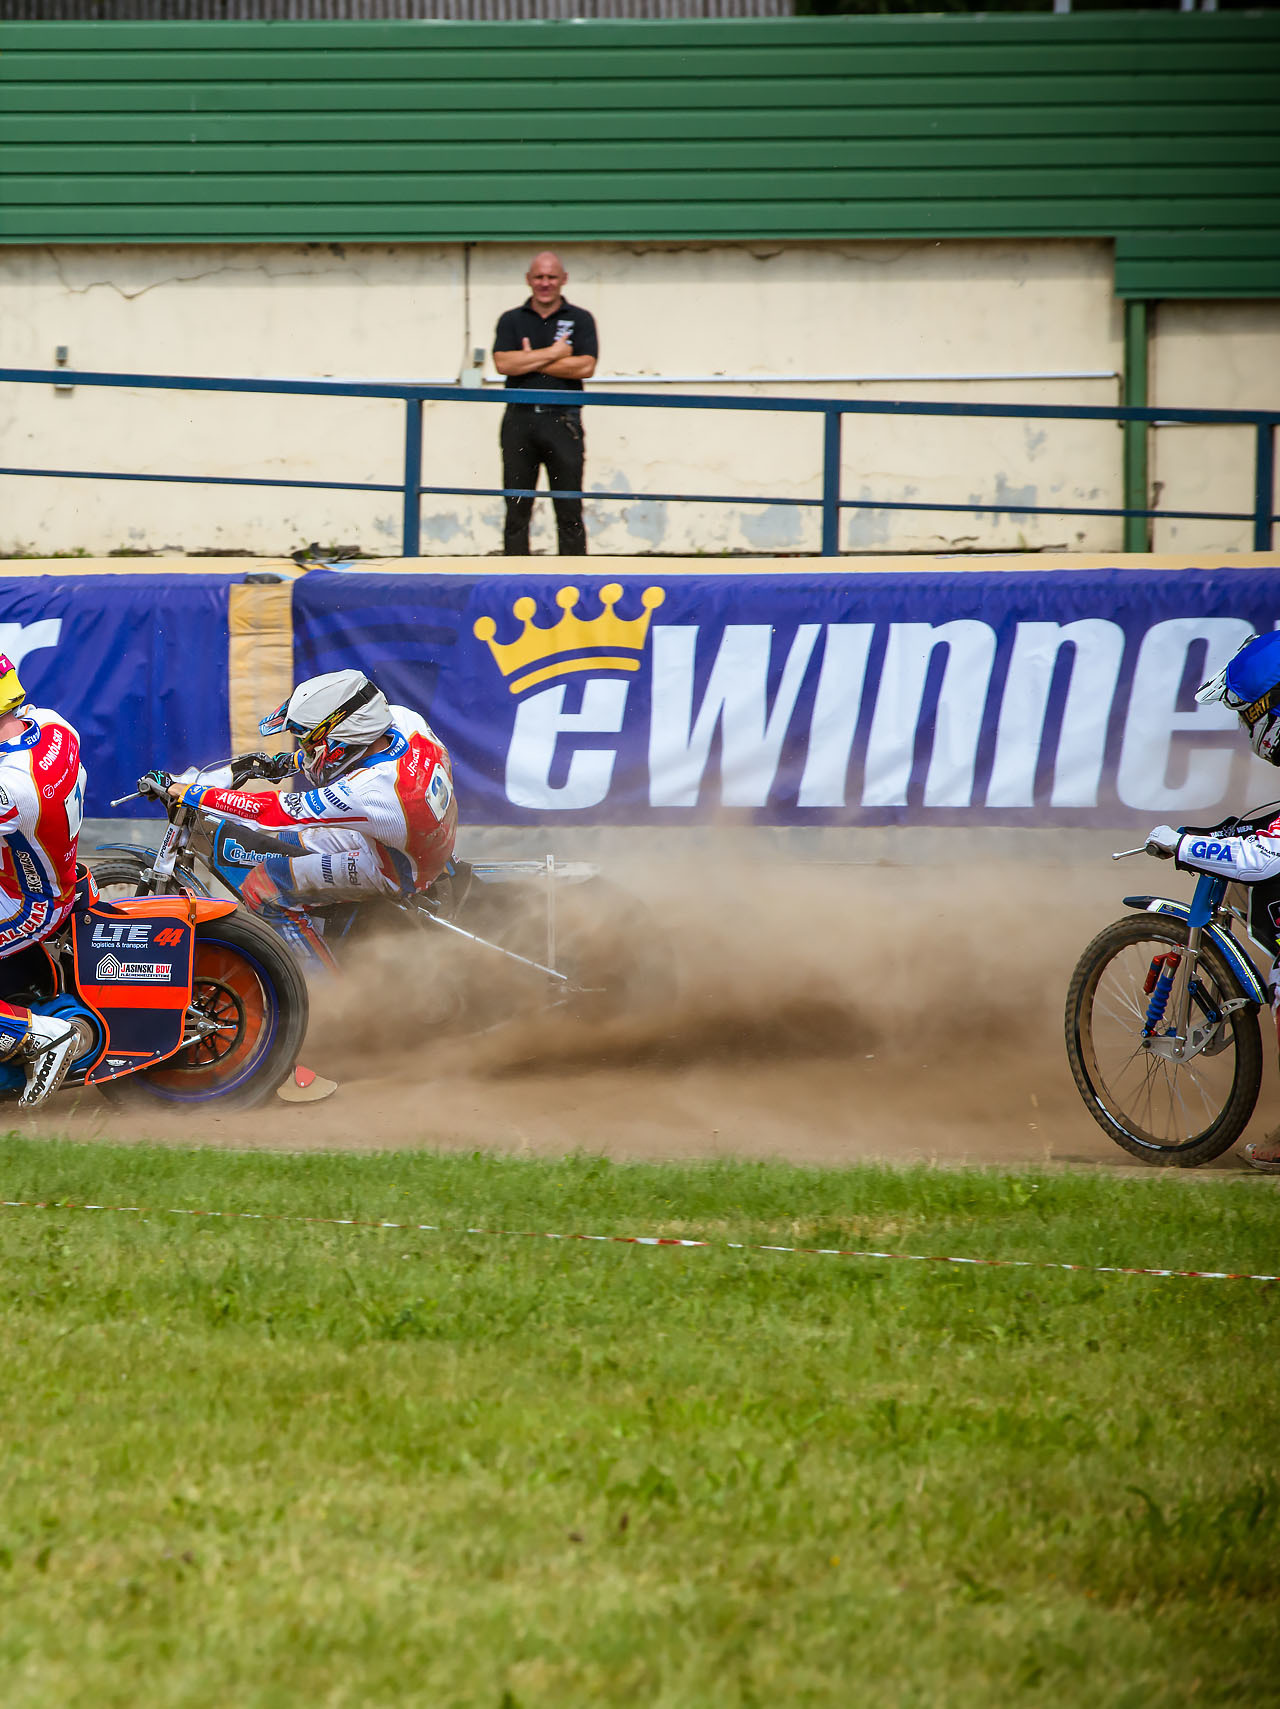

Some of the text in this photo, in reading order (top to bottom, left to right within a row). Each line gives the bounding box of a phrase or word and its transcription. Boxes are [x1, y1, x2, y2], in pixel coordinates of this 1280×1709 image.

[505, 616, 1280, 812] eWinne
[217, 791, 261, 814] AVIDES
[1191, 840, 1232, 863] GPA
[91, 923, 153, 943] LTE
[153, 927, 185, 947] 44
[121, 942, 149, 950] transport
[120, 963, 154, 974] JASINSKI
